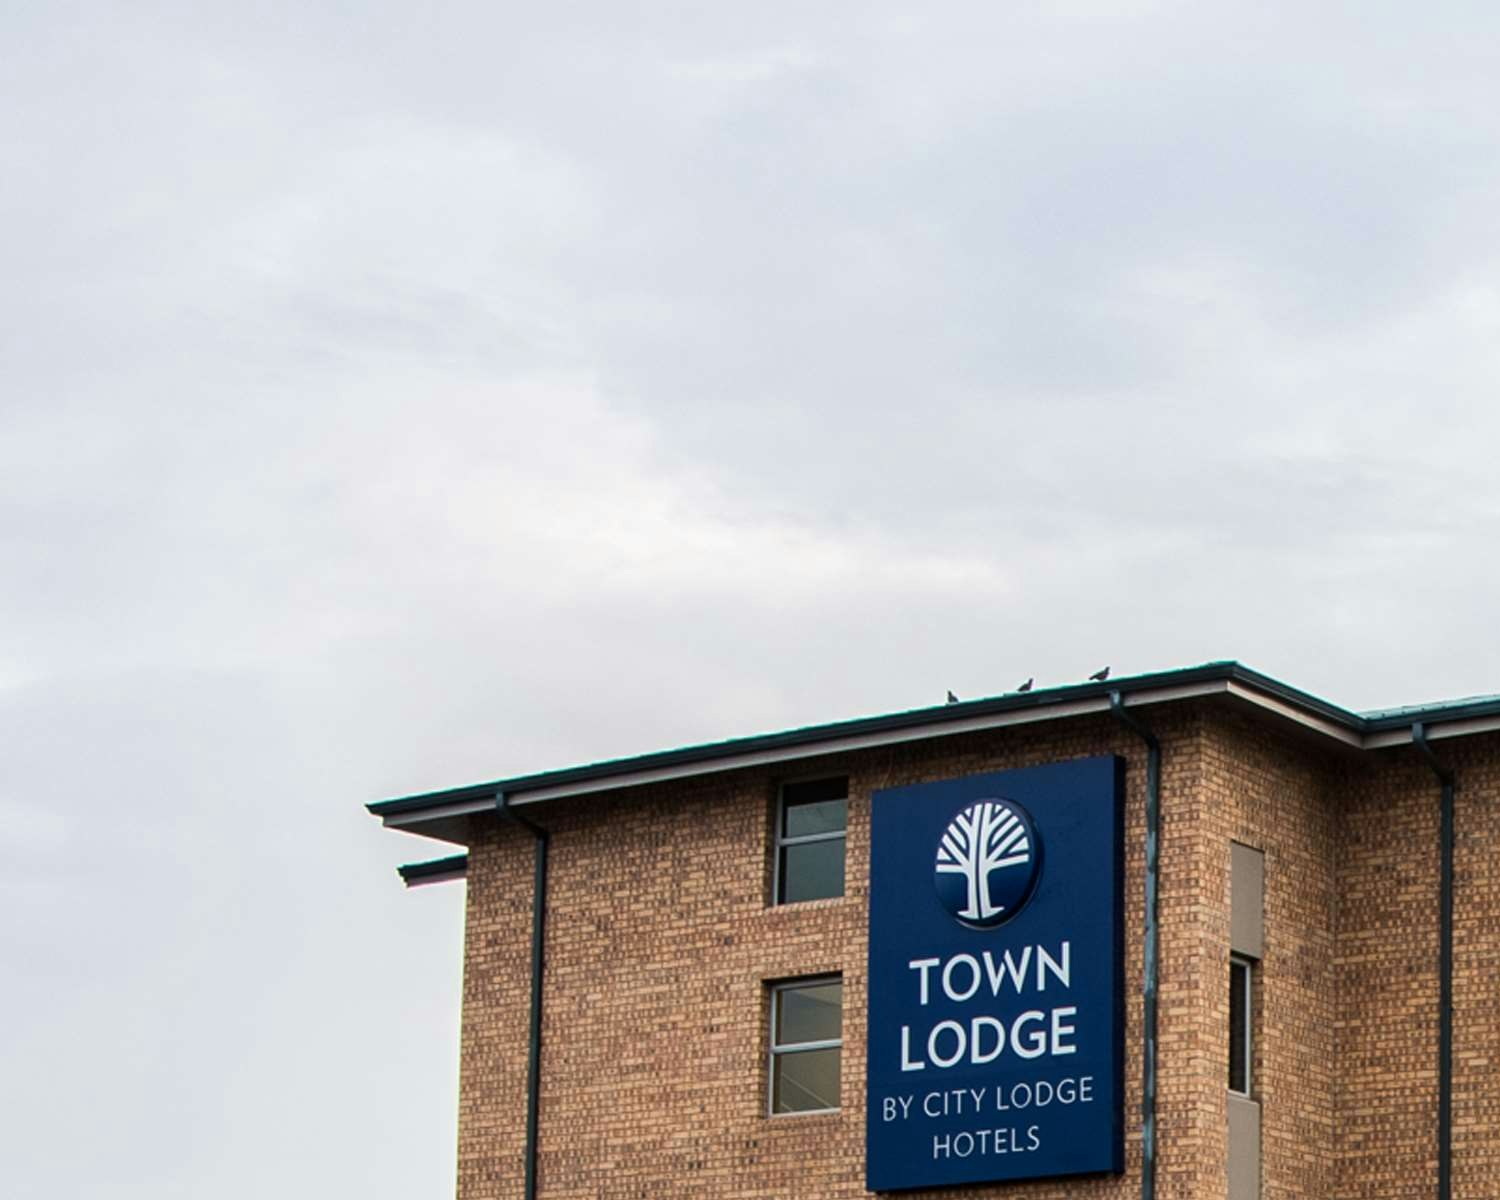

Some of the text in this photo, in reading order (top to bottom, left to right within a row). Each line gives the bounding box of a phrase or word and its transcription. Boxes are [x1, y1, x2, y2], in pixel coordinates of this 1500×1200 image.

[908, 941, 1070, 1005] TOWN
[901, 1006, 1077, 1072] LODGE
[882, 1076, 1094, 1122] BY CITY LODGE
[932, 1125, 1041, 1160] HOTELS
